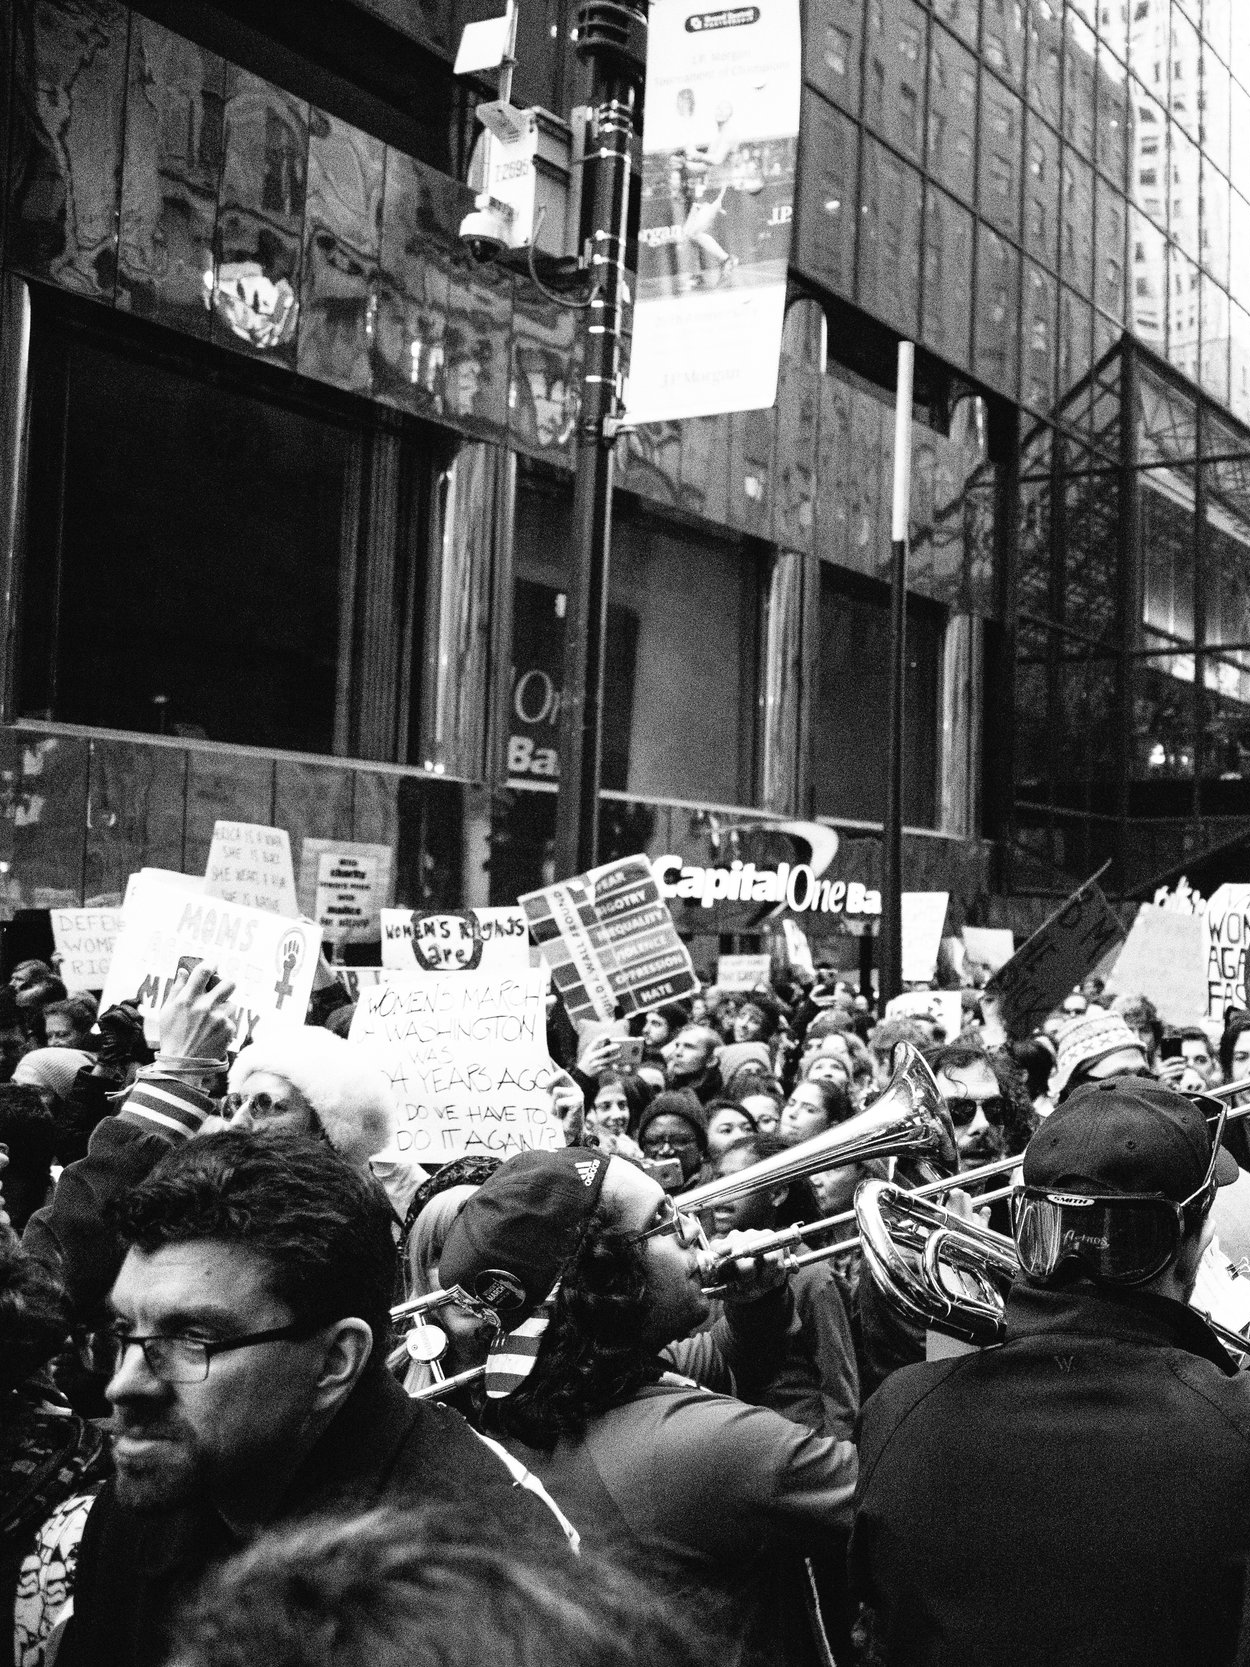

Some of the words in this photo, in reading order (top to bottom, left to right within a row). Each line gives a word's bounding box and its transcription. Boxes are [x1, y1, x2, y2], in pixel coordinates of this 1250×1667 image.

[640, 982, 674, 1003] HATE
[466, 1104, 517, 1123] HAVE
[523, 1107, 548, 1125] TO
[396, 1129, 431, 1152] DO
[1053, 1195, 1089, 1206] SMITH
